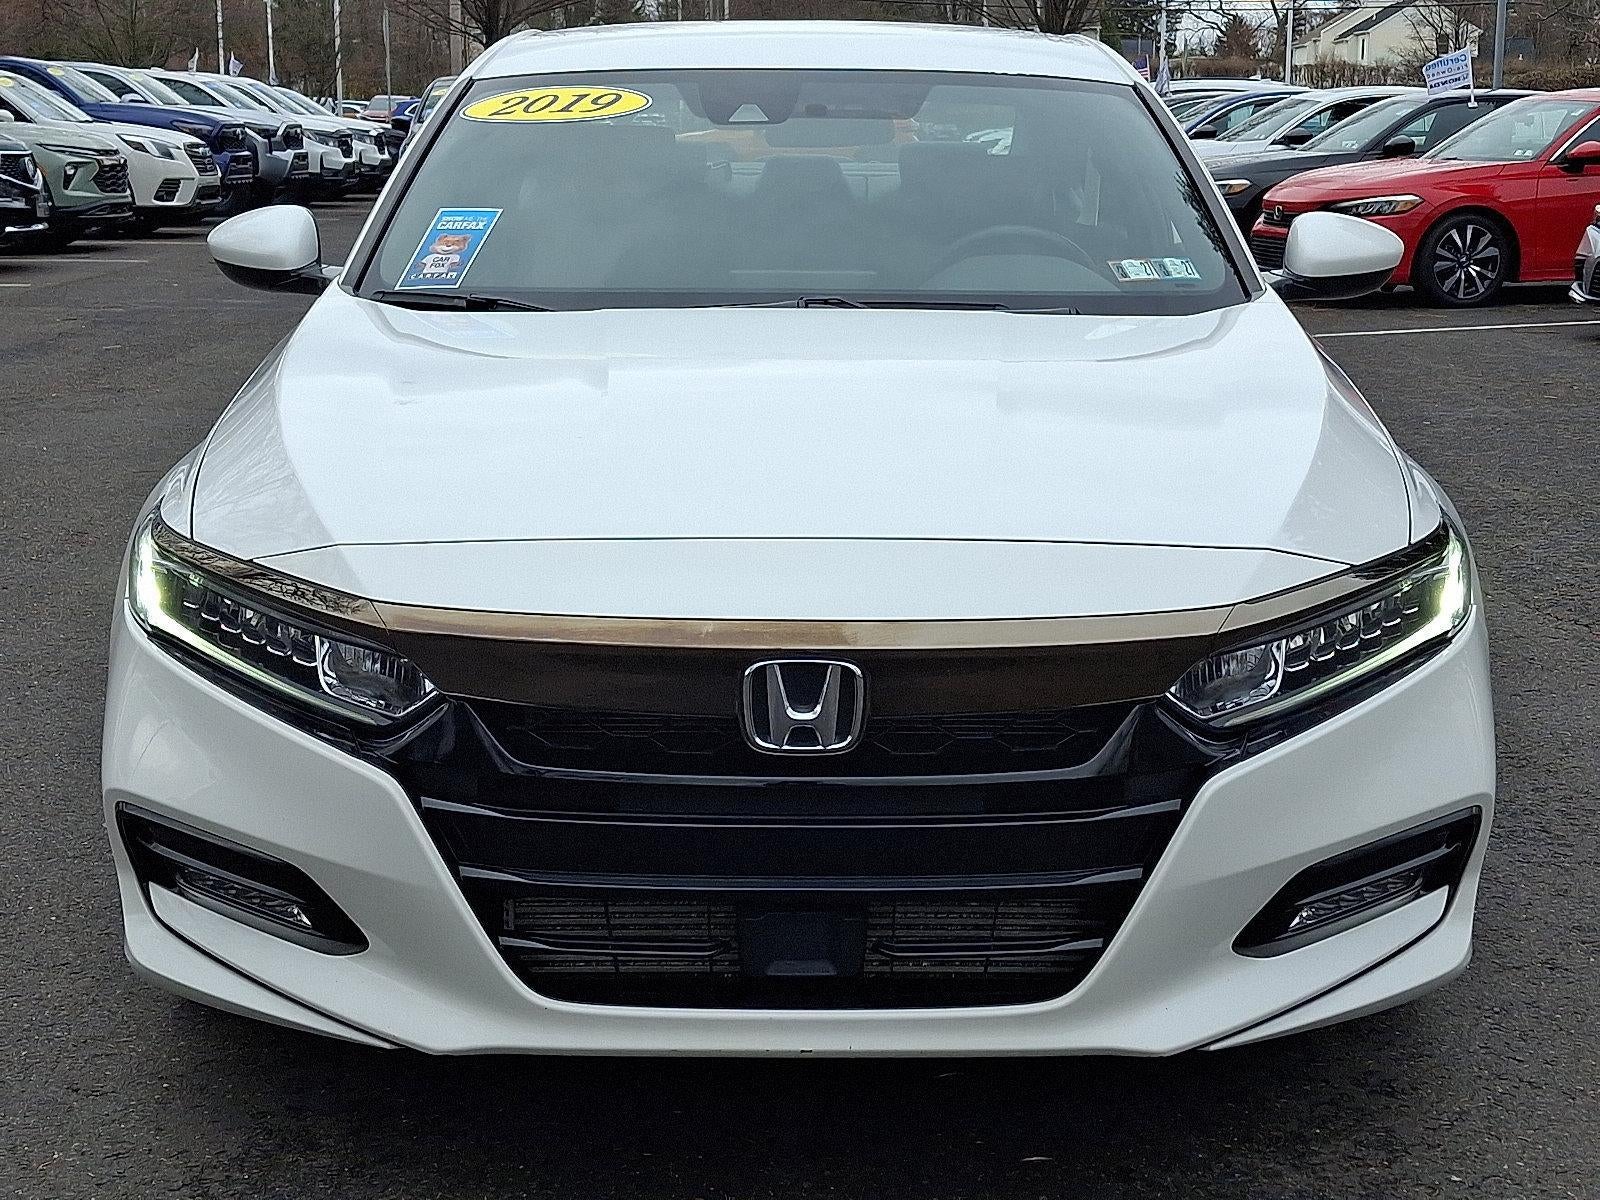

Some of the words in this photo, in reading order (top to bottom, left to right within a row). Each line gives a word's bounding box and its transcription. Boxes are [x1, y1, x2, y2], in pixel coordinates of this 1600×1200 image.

[487, 92, 623, 117] 2019
[436, 221, 487, 230] CARFAX
[1139, 261, 1155, 276] 21
[1180, 260, 1196, 276] 21
